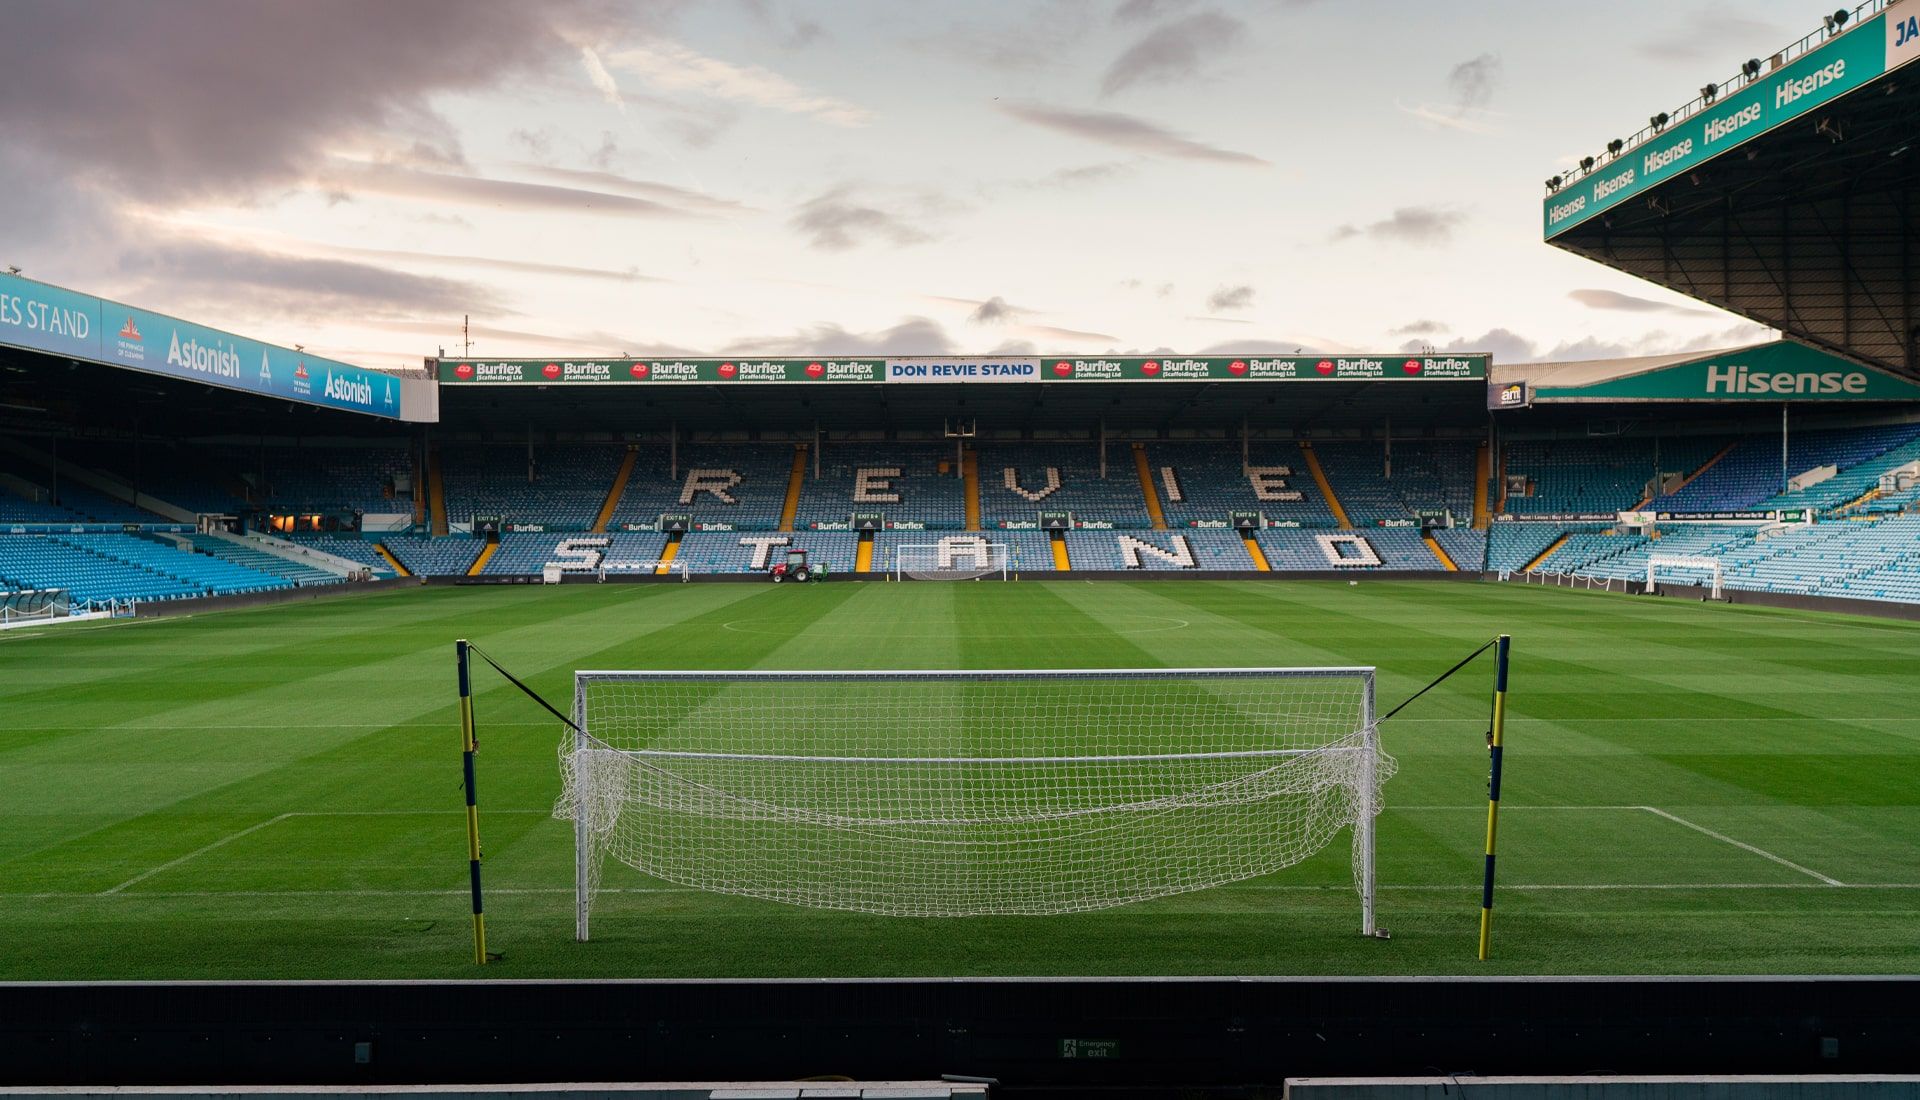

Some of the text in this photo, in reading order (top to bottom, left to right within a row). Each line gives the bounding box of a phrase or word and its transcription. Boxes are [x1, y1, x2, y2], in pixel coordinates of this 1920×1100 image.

[1895, 15, 1920, 47] JA
[1775, 58, 1845, 110] Hisense
[1703, 101, 1761, 145] Hisense
[1643, 137, 1692, 176] Hisense
[1593, 168, 1634, 202] Hisense
[1549, 195, 1586, 226] Hisense
[27, 299, 89, 339] STAND
[167, 328, 240, 379] Astonish
[477, 363, 522, 374] Burflex
[564, 363, 609, 374] Burflex
[652, 362, 697, 373] Burflex
[740, 362, 785, 373] Burflex
[827, 362, 872, 373] Burflex
[1075, 360, 1120, 371] Burflex
[1163, 360, 1208, 371] Burflex
[1250, 360, 1295, 370] Burflex
[1337, 359, 1382, 370] Burflex
[1424, 359, 1470, 369] Burflex
[892, 364, 1034, 377] DON REVIE STAND
[1706, 365, 1868, 394] Hisense
[324, 366, 372, 406] Astonish
[514, 524, 543, 532] Burflex
[629, 523, 653, 531] Burflex
[702, 523, 733, 531] Burflex
[818, 522, 847, 530] Burflex
[894, 521, 923, 530] Burflex
[1007, 521, 1036, 529] Burflex
[1083, 521, 1112, 529] Burflex
[1198, 520, 1227, 528] Burflex
[1275, 520, 1299, 528] Burflex
[1385, 519, 1415, 527] Burflex
[1079, 1040, 1116, 1048] Emergency
[1088, 1048, 1107, 1057] exit
